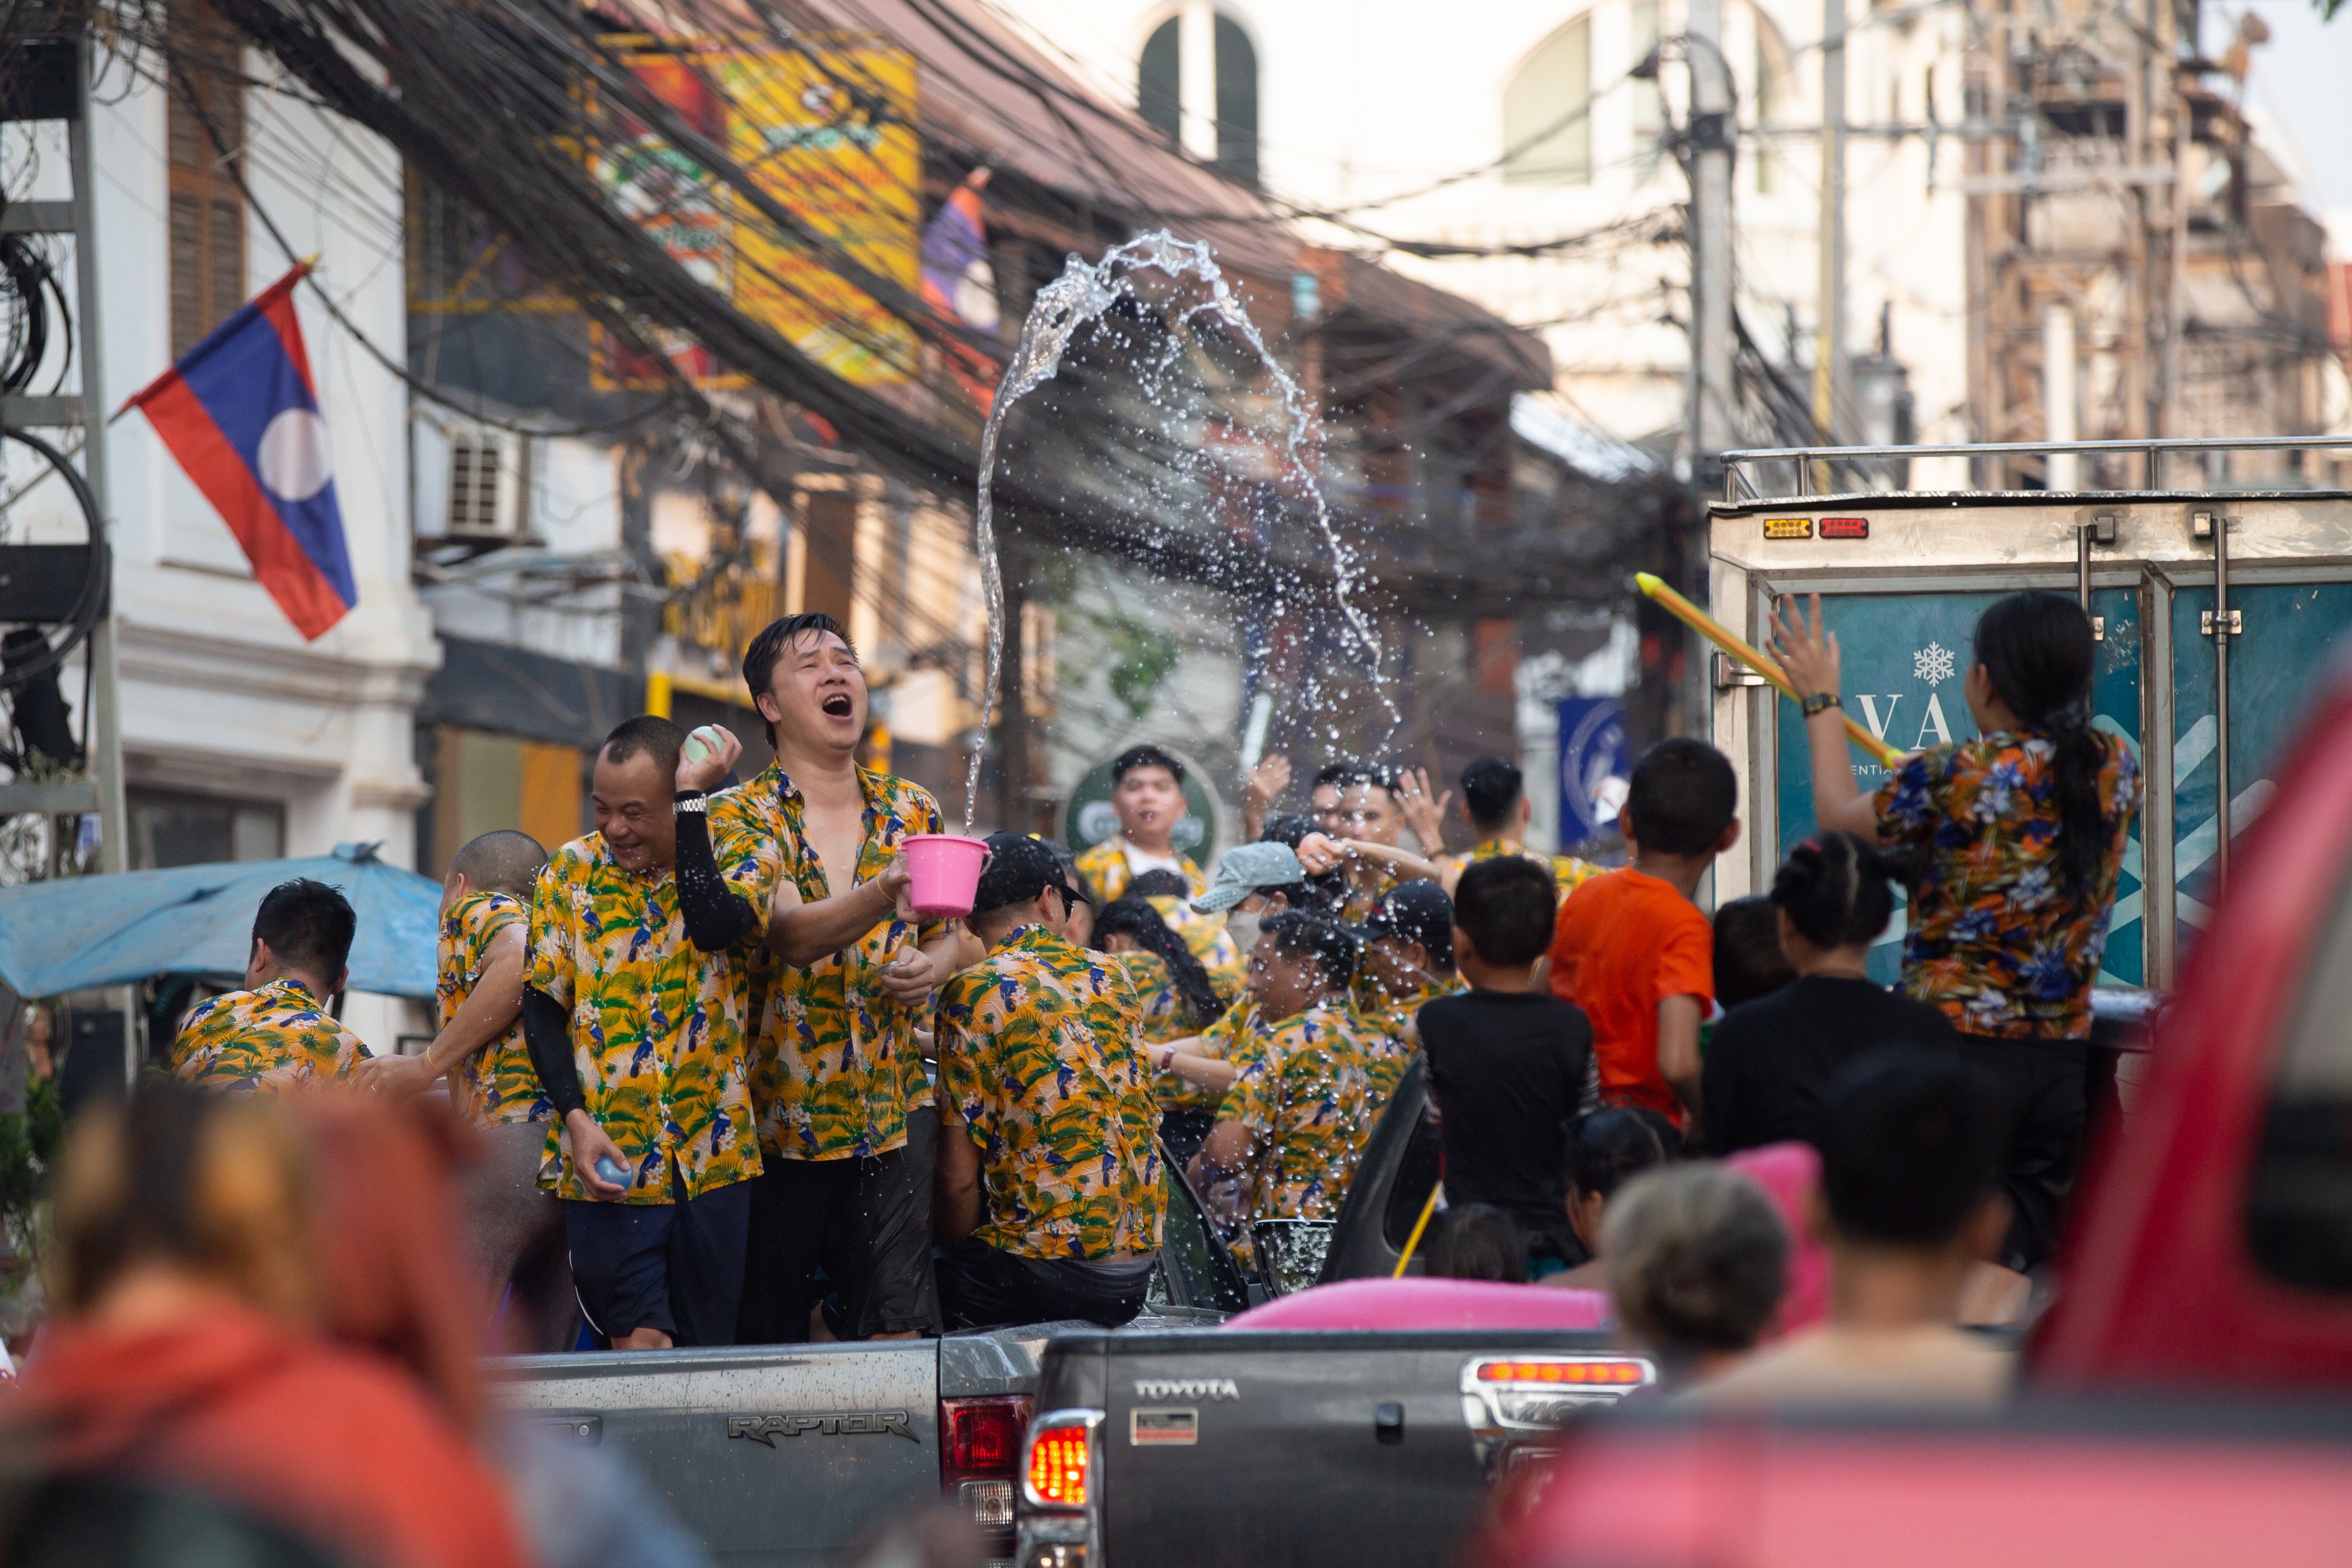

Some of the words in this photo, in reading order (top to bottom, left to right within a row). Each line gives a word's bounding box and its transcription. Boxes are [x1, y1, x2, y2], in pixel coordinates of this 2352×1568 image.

[1855, 693, 1984, 750] VA
[1133, 1379, 1240, 1400] TOYOTA
[728, 1411, 921, 1449] RAPTOR
